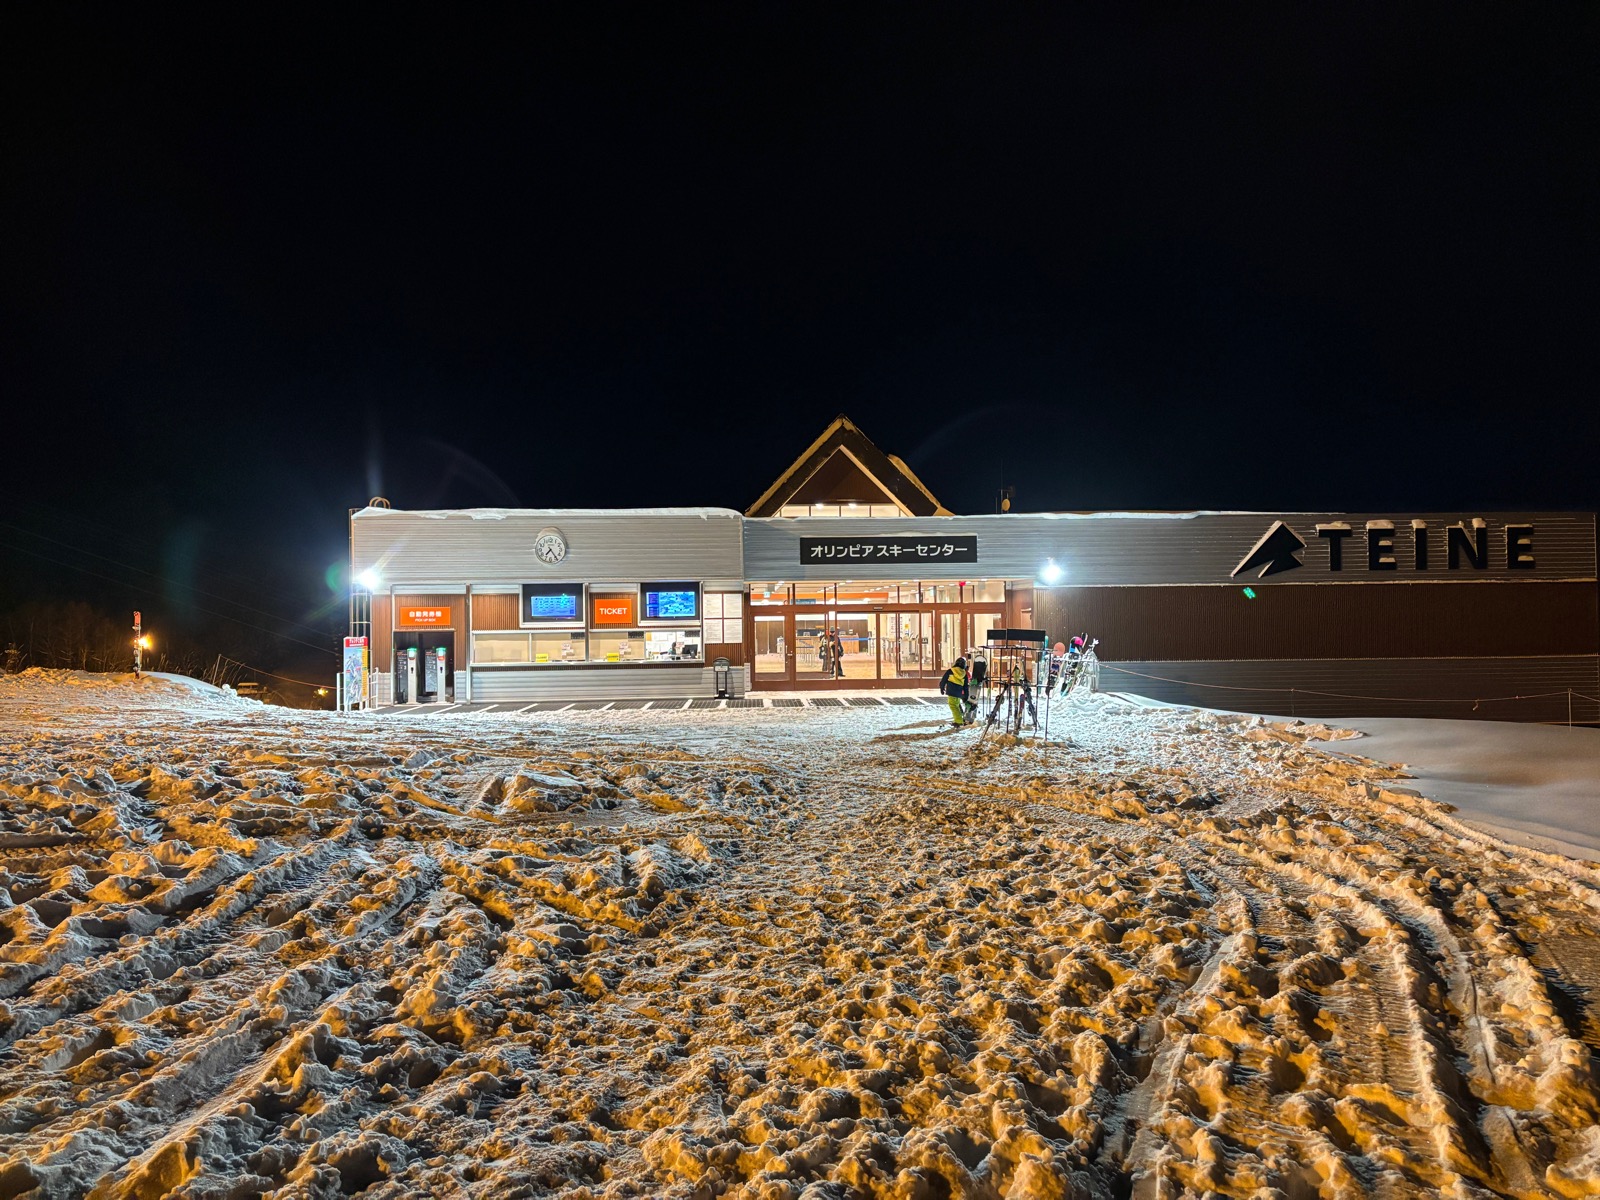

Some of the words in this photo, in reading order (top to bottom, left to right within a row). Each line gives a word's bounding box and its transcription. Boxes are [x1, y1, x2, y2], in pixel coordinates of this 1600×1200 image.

[810, 544, 874, 558] オリンピア
[876, 543, 968, 557] スキーセンター
[1316, 523, 1536, 571] TEINE
[599, 607, 628, 615] TICKET
